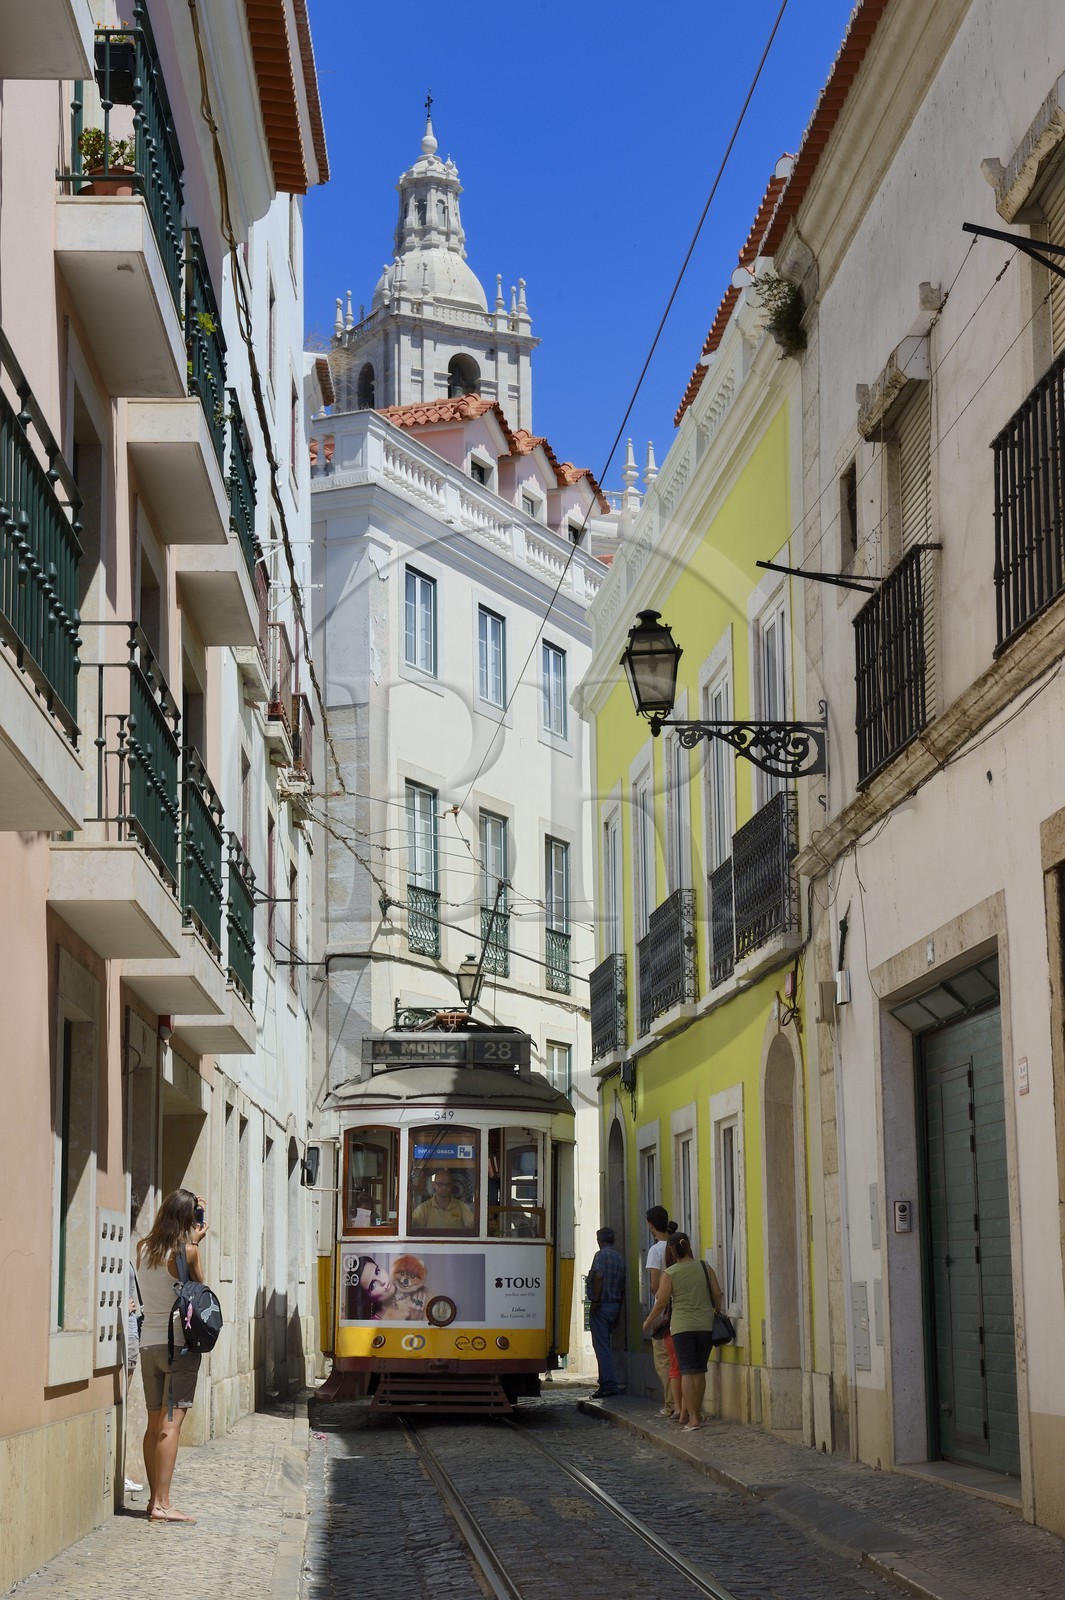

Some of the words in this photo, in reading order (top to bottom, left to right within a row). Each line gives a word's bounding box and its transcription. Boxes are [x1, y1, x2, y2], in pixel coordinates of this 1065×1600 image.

[401, 1041, 459, 1054] MONIZ
[483, 1041, 512, 1060] 28
[433, 1110, 455, 1121] 549
[504, 1277, 541, 1289] TOUS
